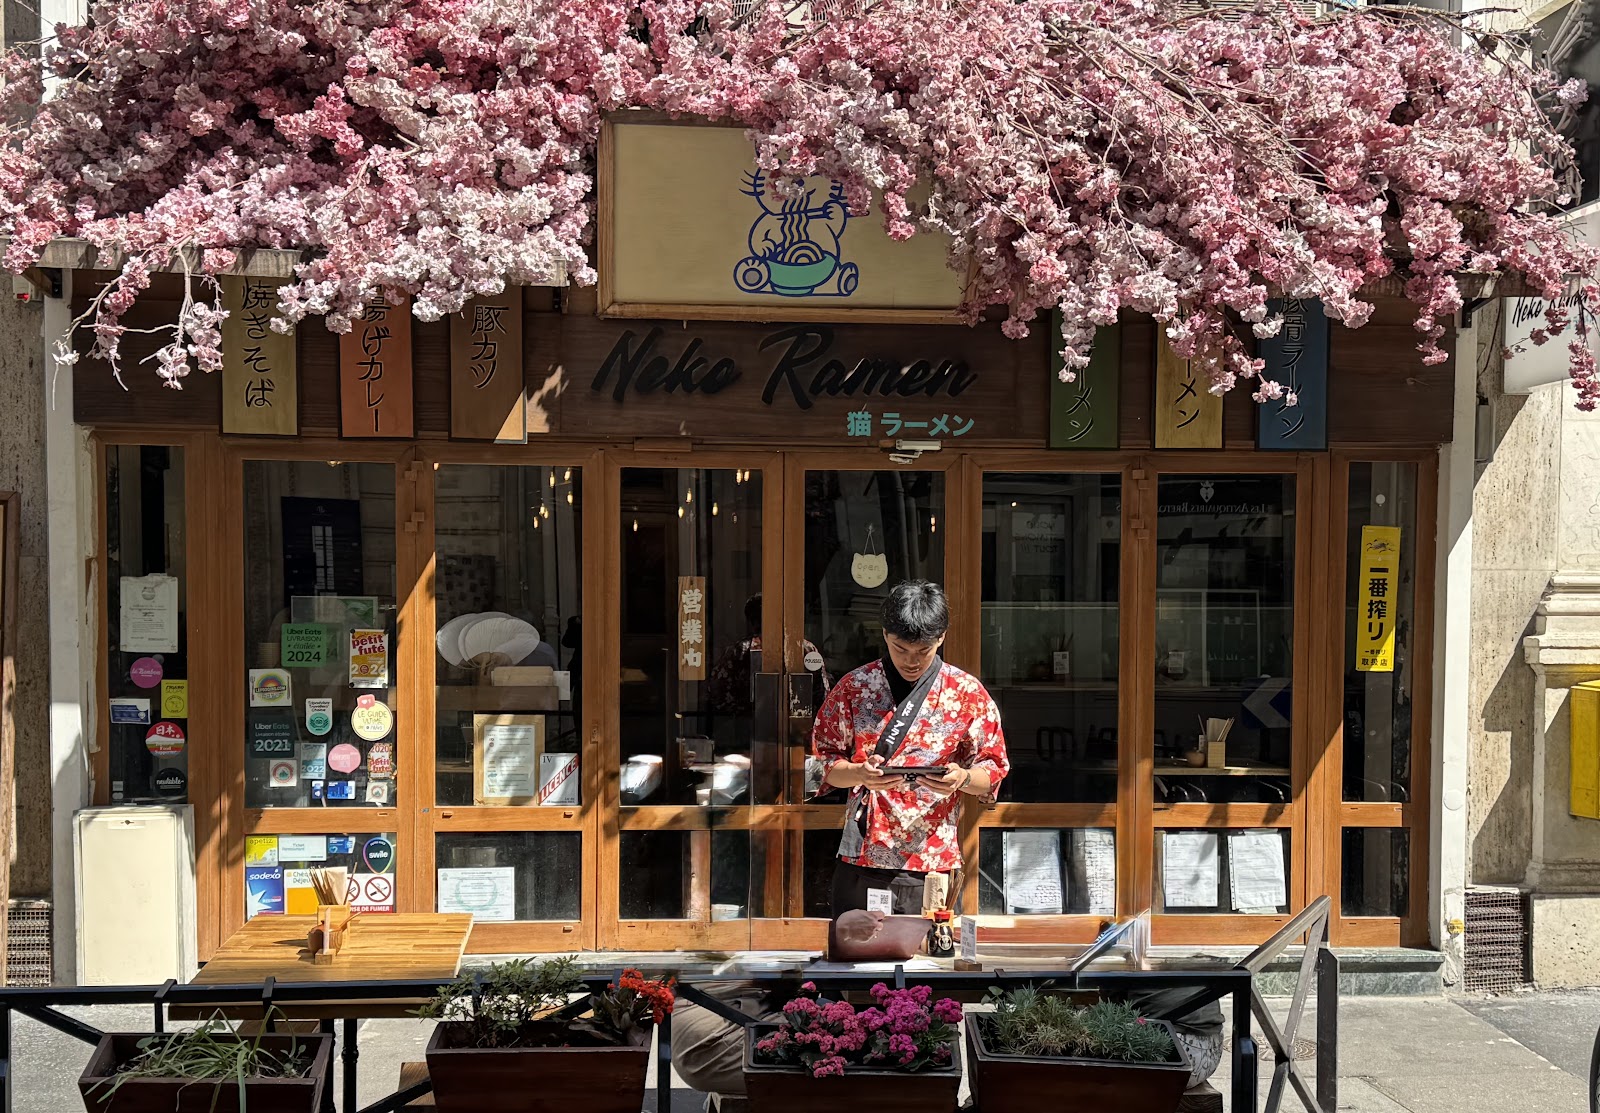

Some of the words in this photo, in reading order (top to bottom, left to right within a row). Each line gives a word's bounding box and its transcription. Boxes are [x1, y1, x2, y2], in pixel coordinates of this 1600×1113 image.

[240, 276, 276, 408] 焼きそば
[470, 304, 510, 390] 豚カツ
[355, 284, 393, 432] 揚げカレー
[590, 326, 743, 402] Neko
[758, 325, 979, 411] Ramen
[1066, 352, 1095, 442] ーメン
[846, 411, 872, 437] 猫
[880, 412, 975, 437] ラーメン
[1368, 567, 1389, 641] 一番搾り
[351, 634, 384, 649] petit
[358, 643, 386, 655] futé
[287, 650, 321, 662] 2024
[155, 725, 176, 735] 日本
[255, 739, 291, 752] 2021
[542, 755, 553, 763] IV
[301, 765, 325, 773] 2022
[541, 757, 578, 799] LICENCE
[368, 850, 389, 859] swile
[249, 870, 282, 881] sodexo
